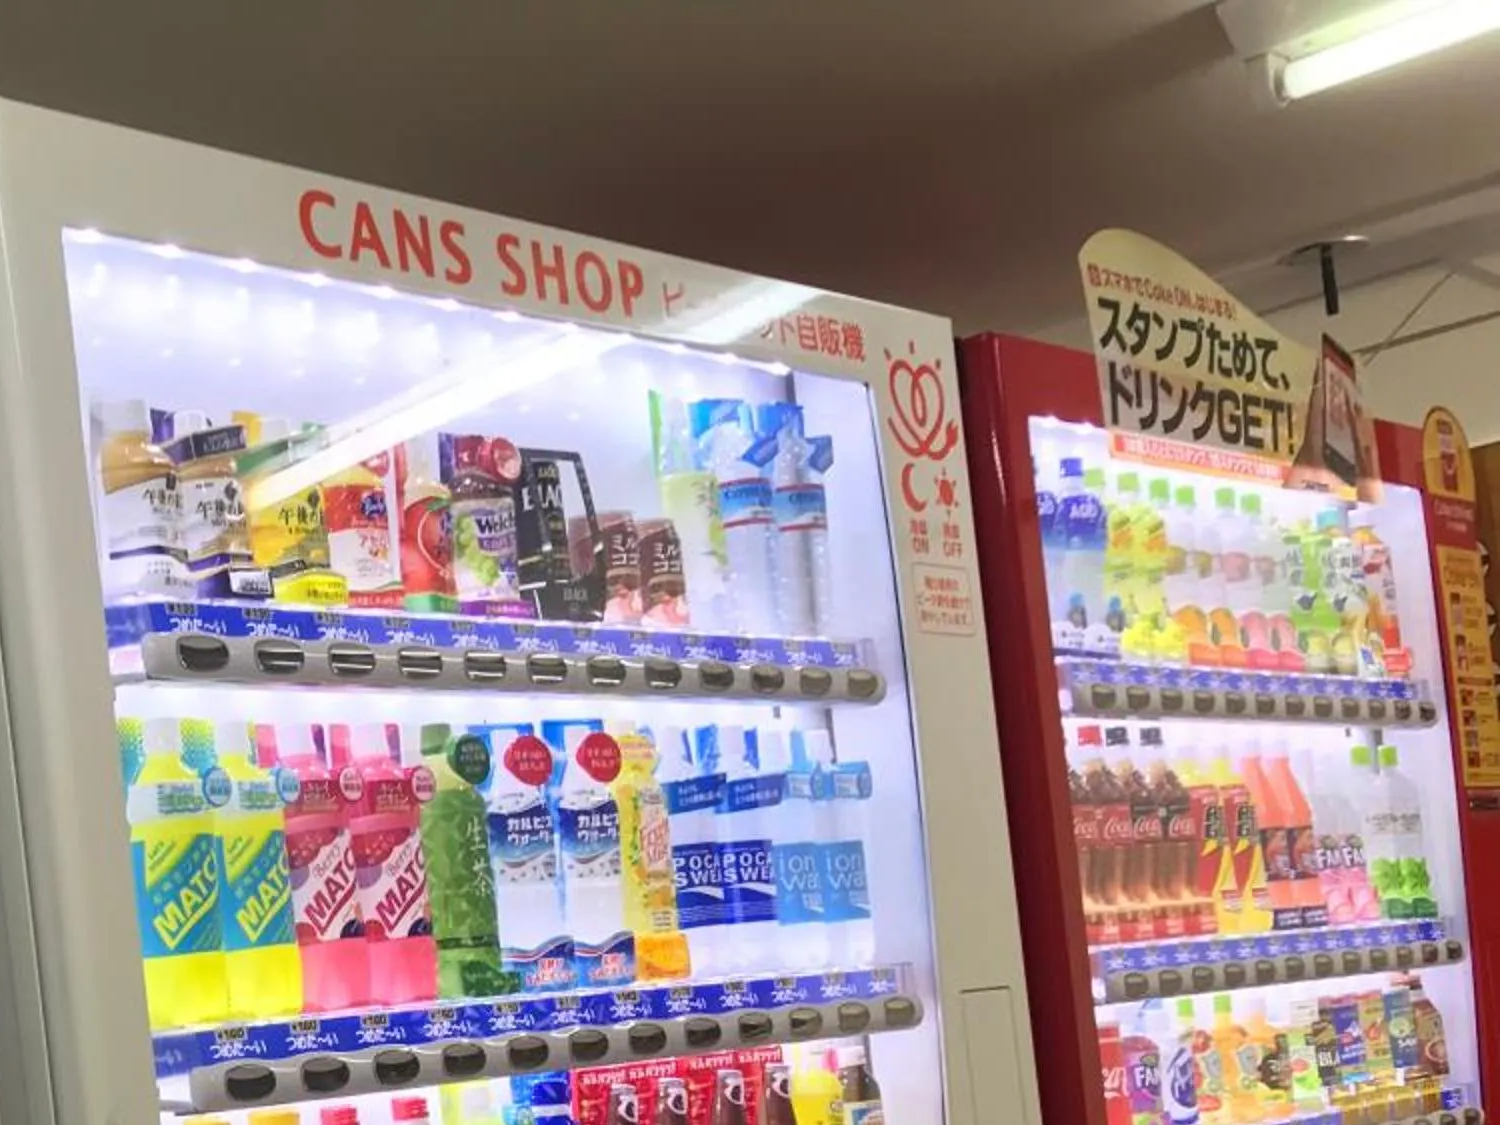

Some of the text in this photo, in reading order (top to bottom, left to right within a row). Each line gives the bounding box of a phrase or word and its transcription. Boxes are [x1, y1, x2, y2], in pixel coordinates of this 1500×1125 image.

[297, 188, 474, 286] CANS
[495, 231, 646, 319] SHOP
[1097, 296, 1291, 391] スタンプためて、
[1108, 360, 1296, 455] ドリンクGET!
